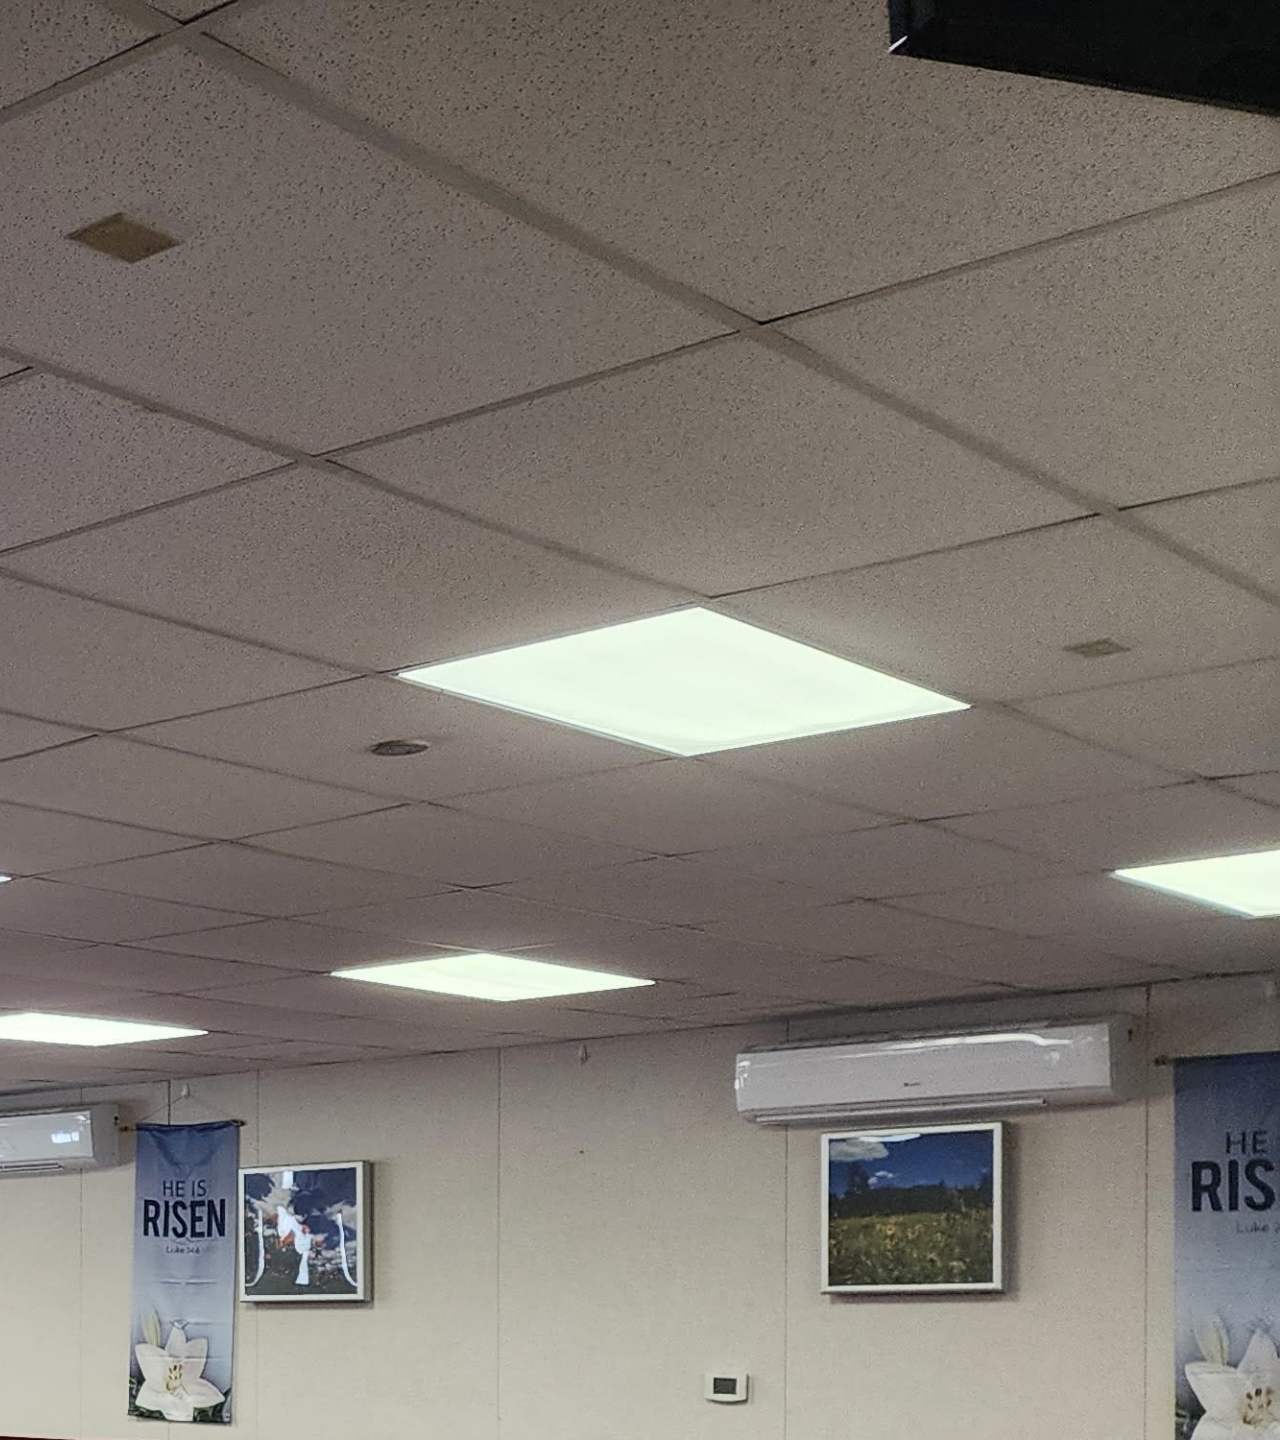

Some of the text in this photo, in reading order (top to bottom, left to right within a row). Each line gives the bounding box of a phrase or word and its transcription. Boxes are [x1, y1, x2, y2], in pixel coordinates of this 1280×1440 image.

[1226, 1130, 1269, 1154] HE
[162, 1178, 207, 1197] HE IS
[1191, 1158, 1277, 1212] RIS
[143, 1198, 226, 1239] RISEN
